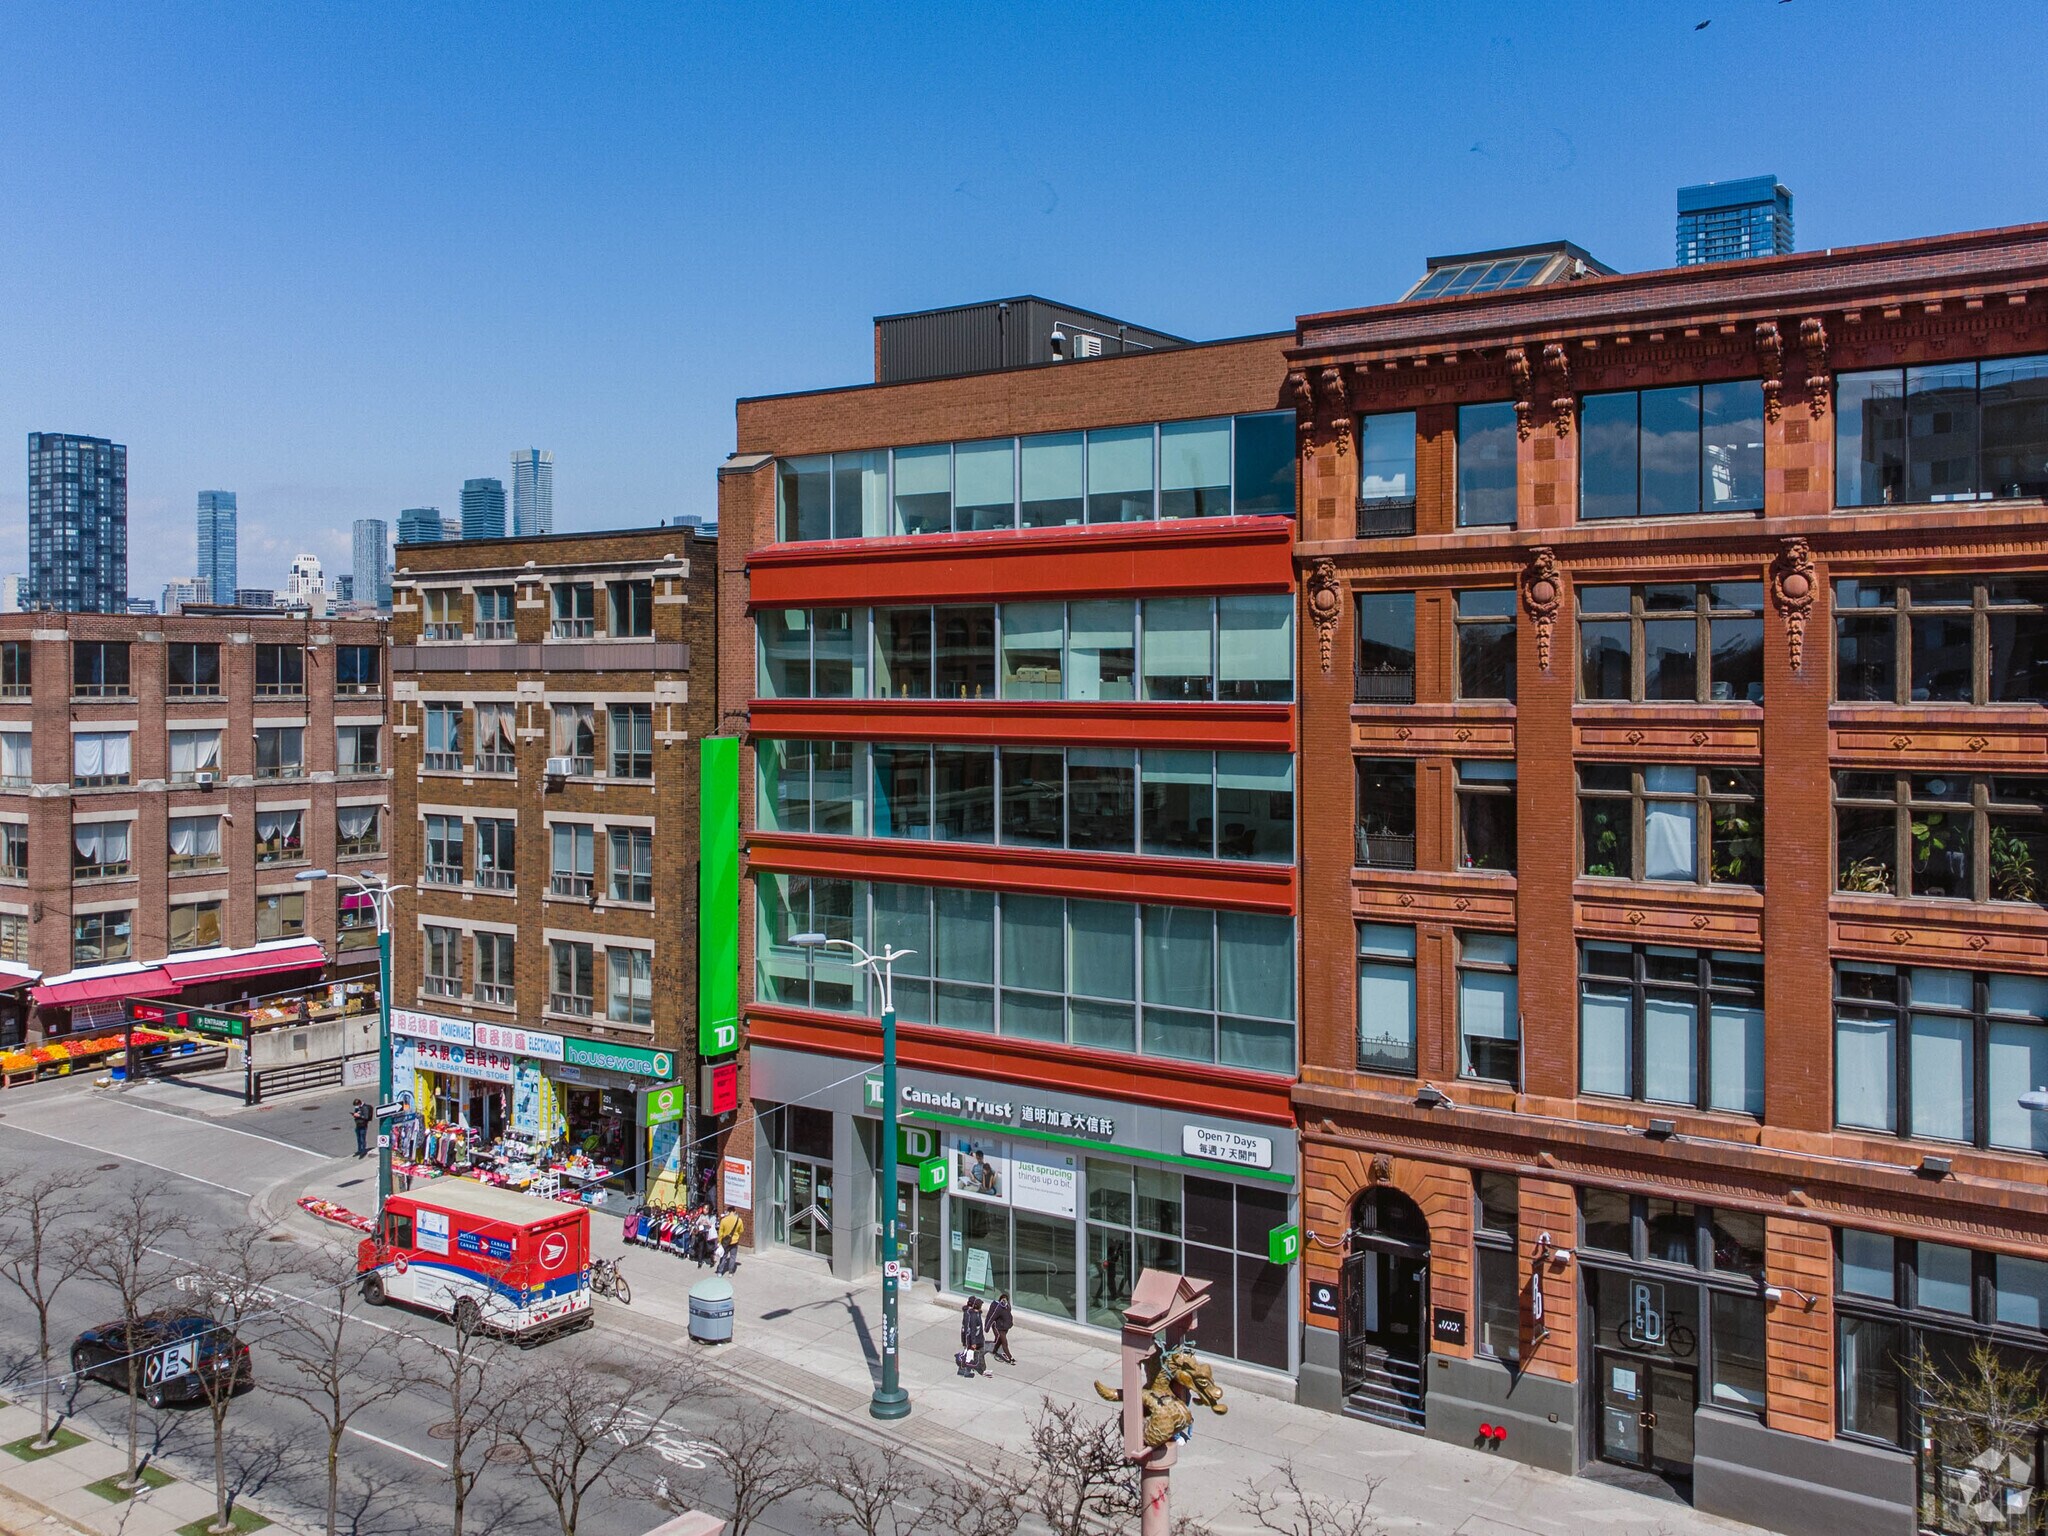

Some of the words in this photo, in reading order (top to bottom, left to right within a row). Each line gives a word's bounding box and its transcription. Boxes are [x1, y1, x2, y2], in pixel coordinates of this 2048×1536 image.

[204, 1017, 228, 1027] ENTRANCE
[440, 1021, 471, 1040] HOMEWARE
[528, 1036, 561, 1055] ELECTRONICS
[714, 1025, 735, 1048] TD
[465, 1049, 511, 1071] 百貨中心
[568, 1045, 652, 1074] houseware
[419, 1060, 434, 1068] A&A
[437, 1062, 483, 1076] DEPARTMENT
[486, 1070, 510, 1081] STORE
[902, 1086, 961, 1109] Canada
[964, 1096, 1013, 1118] Trust
[1021, 1105, 1113, 1135] 道明加拿大信託
[900, 1126, 932, 1157] TD
[1197, 1129, 1223, 1142] Open
[1225, 1134, 1231, 1143] 7
[1233, 1135, 1257, 1149] Days
[1220, 1147, 1226, 1156] 7
[1229, 1148, 1257, 1163] 天開門
[930, 1166, 946, 1184] TD
[1018, 1161, 1035, 1172] Just
[1036, 1166, 1073, 1181] sprucing
[1018, 1171, 1041, 1184] things
[1043, 1176, 1052, 1186] up
[1060, 1179, 1073, 1189] bit.
[459, 1241, 478, 1250] CANADA
[490, 1240, 509, 1249] CANADA
[1283, 1235, 1297, 1255] TD
[1635, 1284, 1660, 1340] R&D
